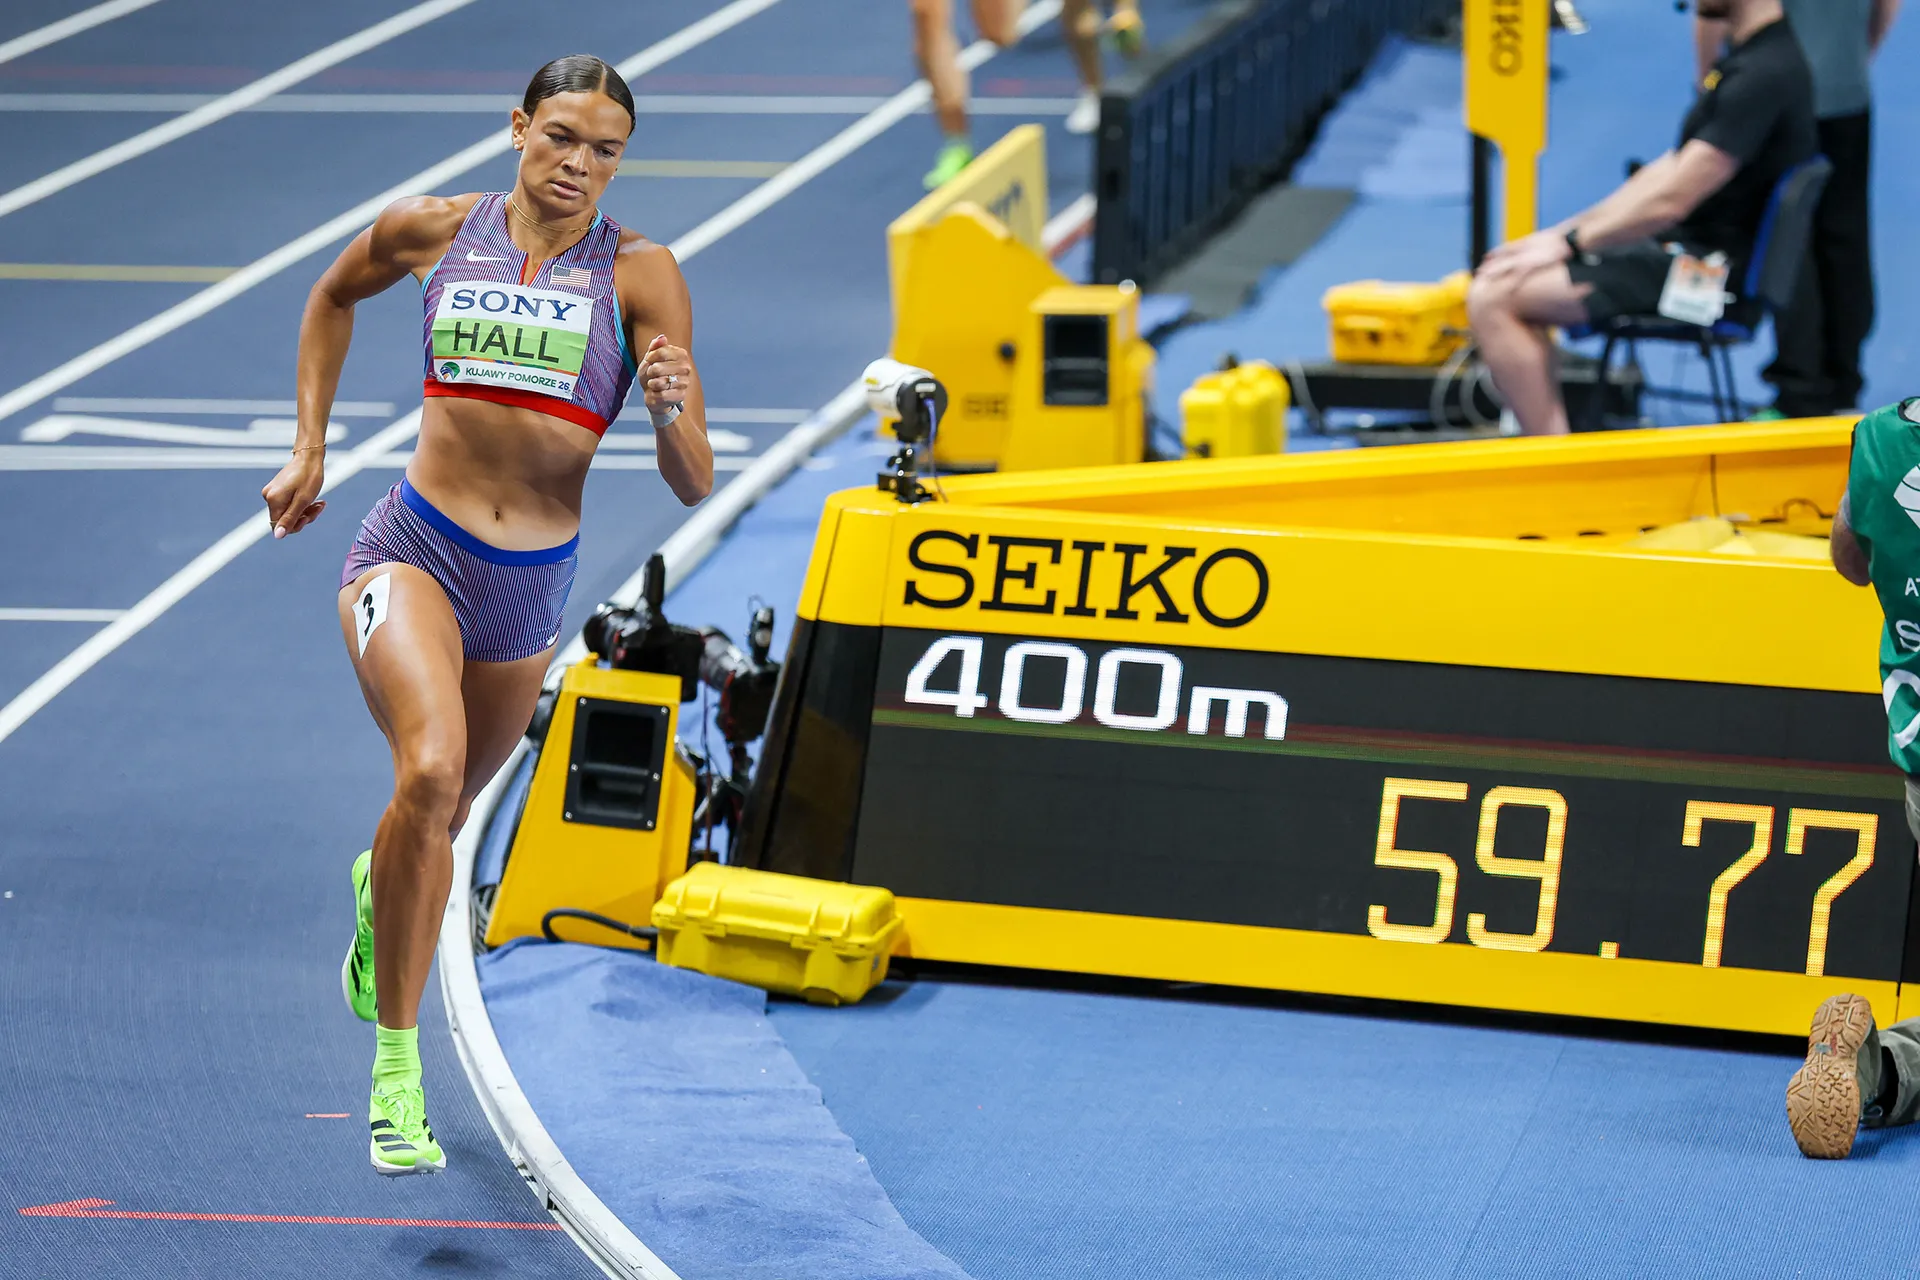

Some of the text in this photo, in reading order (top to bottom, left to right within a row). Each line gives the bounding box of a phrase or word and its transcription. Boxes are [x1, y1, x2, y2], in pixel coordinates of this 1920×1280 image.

[451, 289, 577, 321] SONY
[453, 321, 560, 363] HALL
[465, 367, 571, 391] KUJAWY POMORZE 26
[903, 529, 1270, 628] SEIKO
[363, 593, 375, 637] 3
[904, 635, 1290, 742] 400m
[1367, 776, 1879, 977] 59.77
